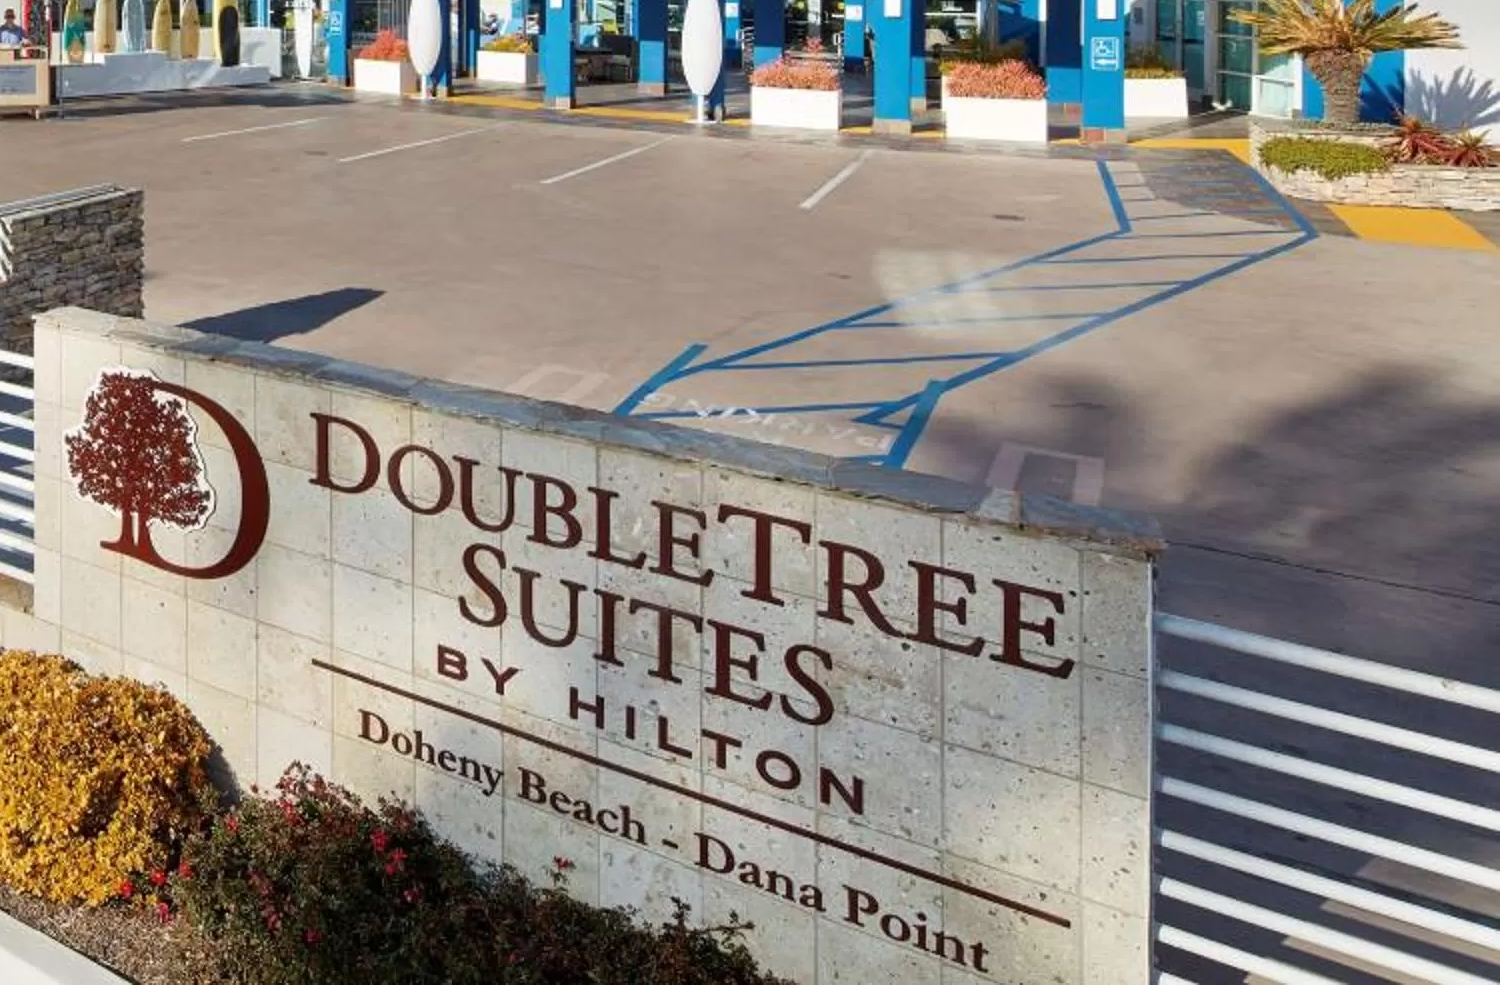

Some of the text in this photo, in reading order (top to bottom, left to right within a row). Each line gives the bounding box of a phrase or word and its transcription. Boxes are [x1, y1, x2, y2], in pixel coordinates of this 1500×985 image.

[309, 412, 1075, 680] DOUBLETREE
[457, 542, 835, 726] SUITES
[359, 710, 505, 797] Doheny
[518, 766, 647, 846] Beach
[694, 832, 826, 912] Dana
[842, 884, 989, 973] Point
[437, 644, 864, 816] BY HILTON
